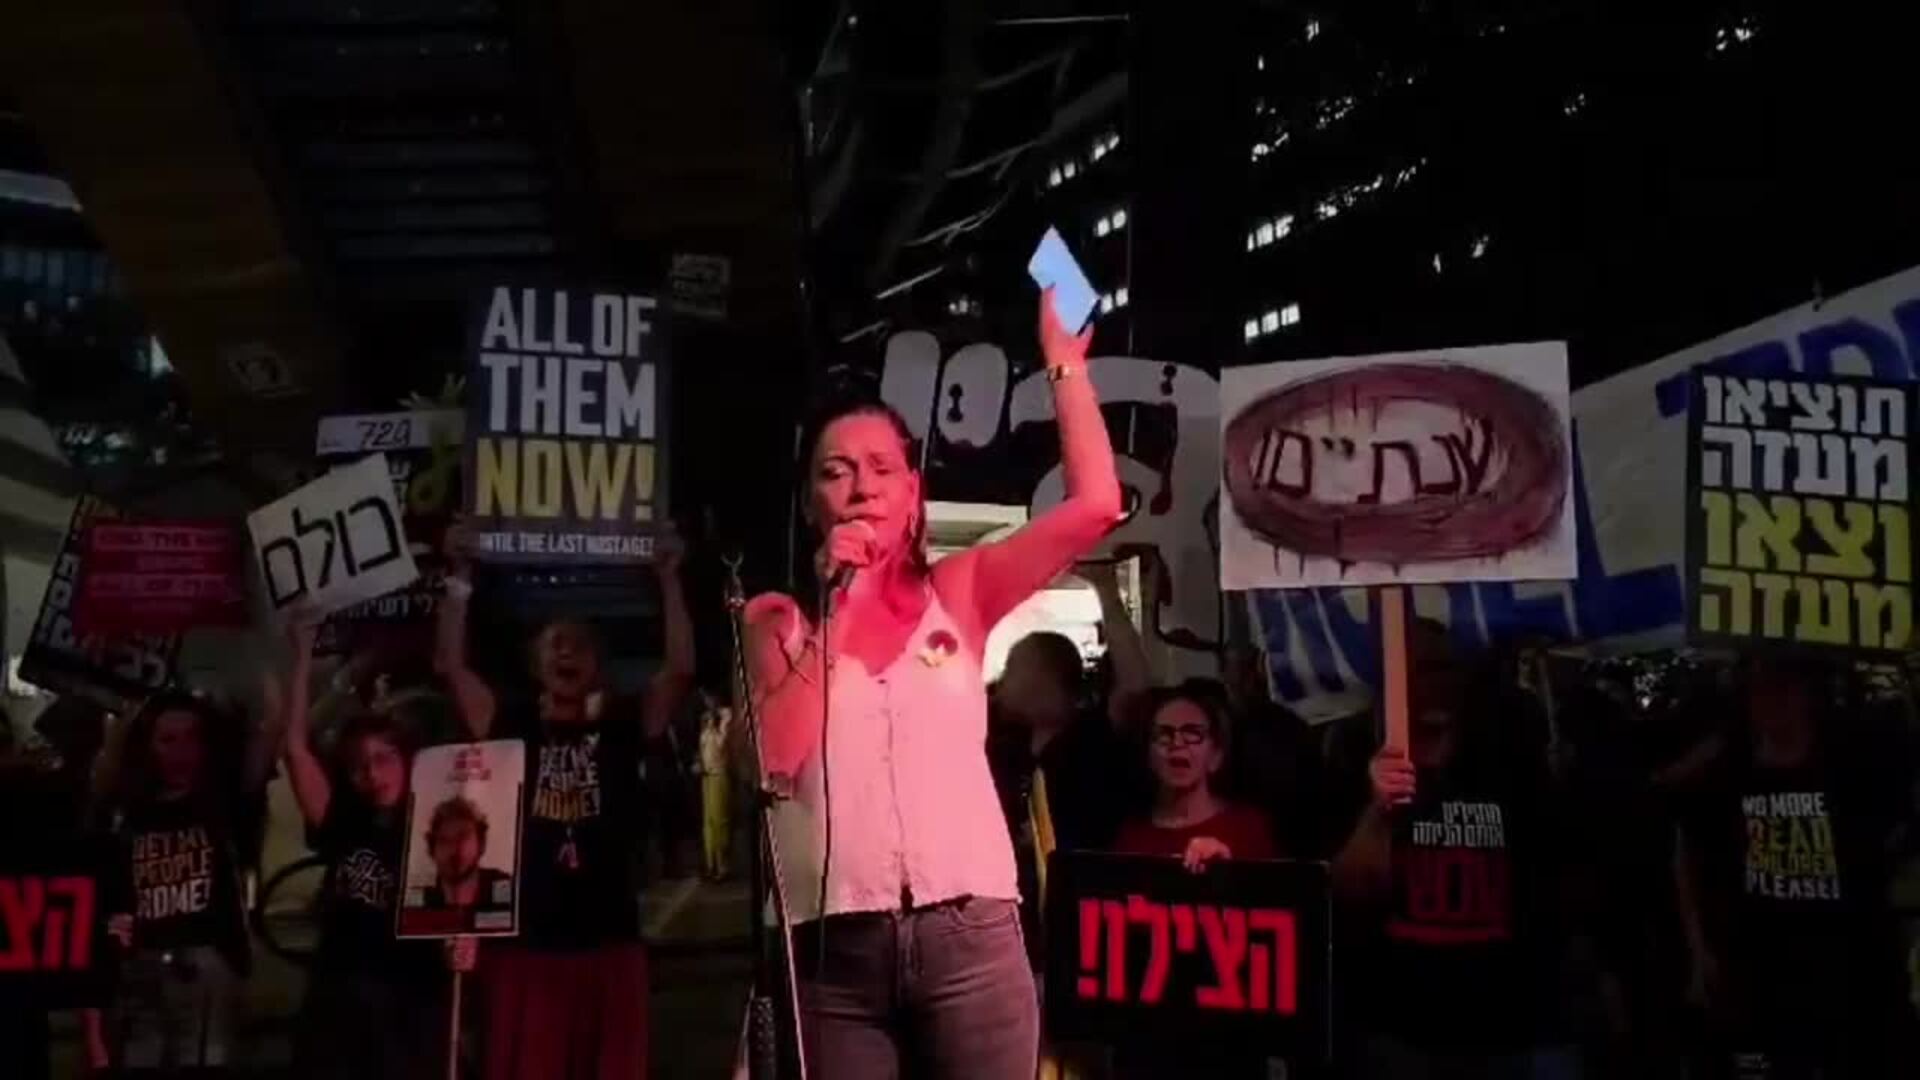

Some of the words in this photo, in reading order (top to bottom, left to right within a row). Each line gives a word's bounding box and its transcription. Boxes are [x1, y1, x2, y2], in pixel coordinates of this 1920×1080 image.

[480, 285, 585, 356] ALL
[592, 293, 657, 359] OF
[479, 351, 656, 440] THEM
[1703, 374, 1908, 437] תוציאו
[475, 436, 656, 521] NOW!
[1701, 424, 1911, 502] מעזה
[262, 496, 400, 610] כולם
[548, 533, 586, 555] LAST
[1701, 489, 1913, 584] וצאו
[1700, 566, 1914, 650] מעזה
[1769, 790, 1826, 817] MORE
[1743, 871, 1841, 900] PLEASE!
[1077, 893, 1297, 1016] הצילו!
